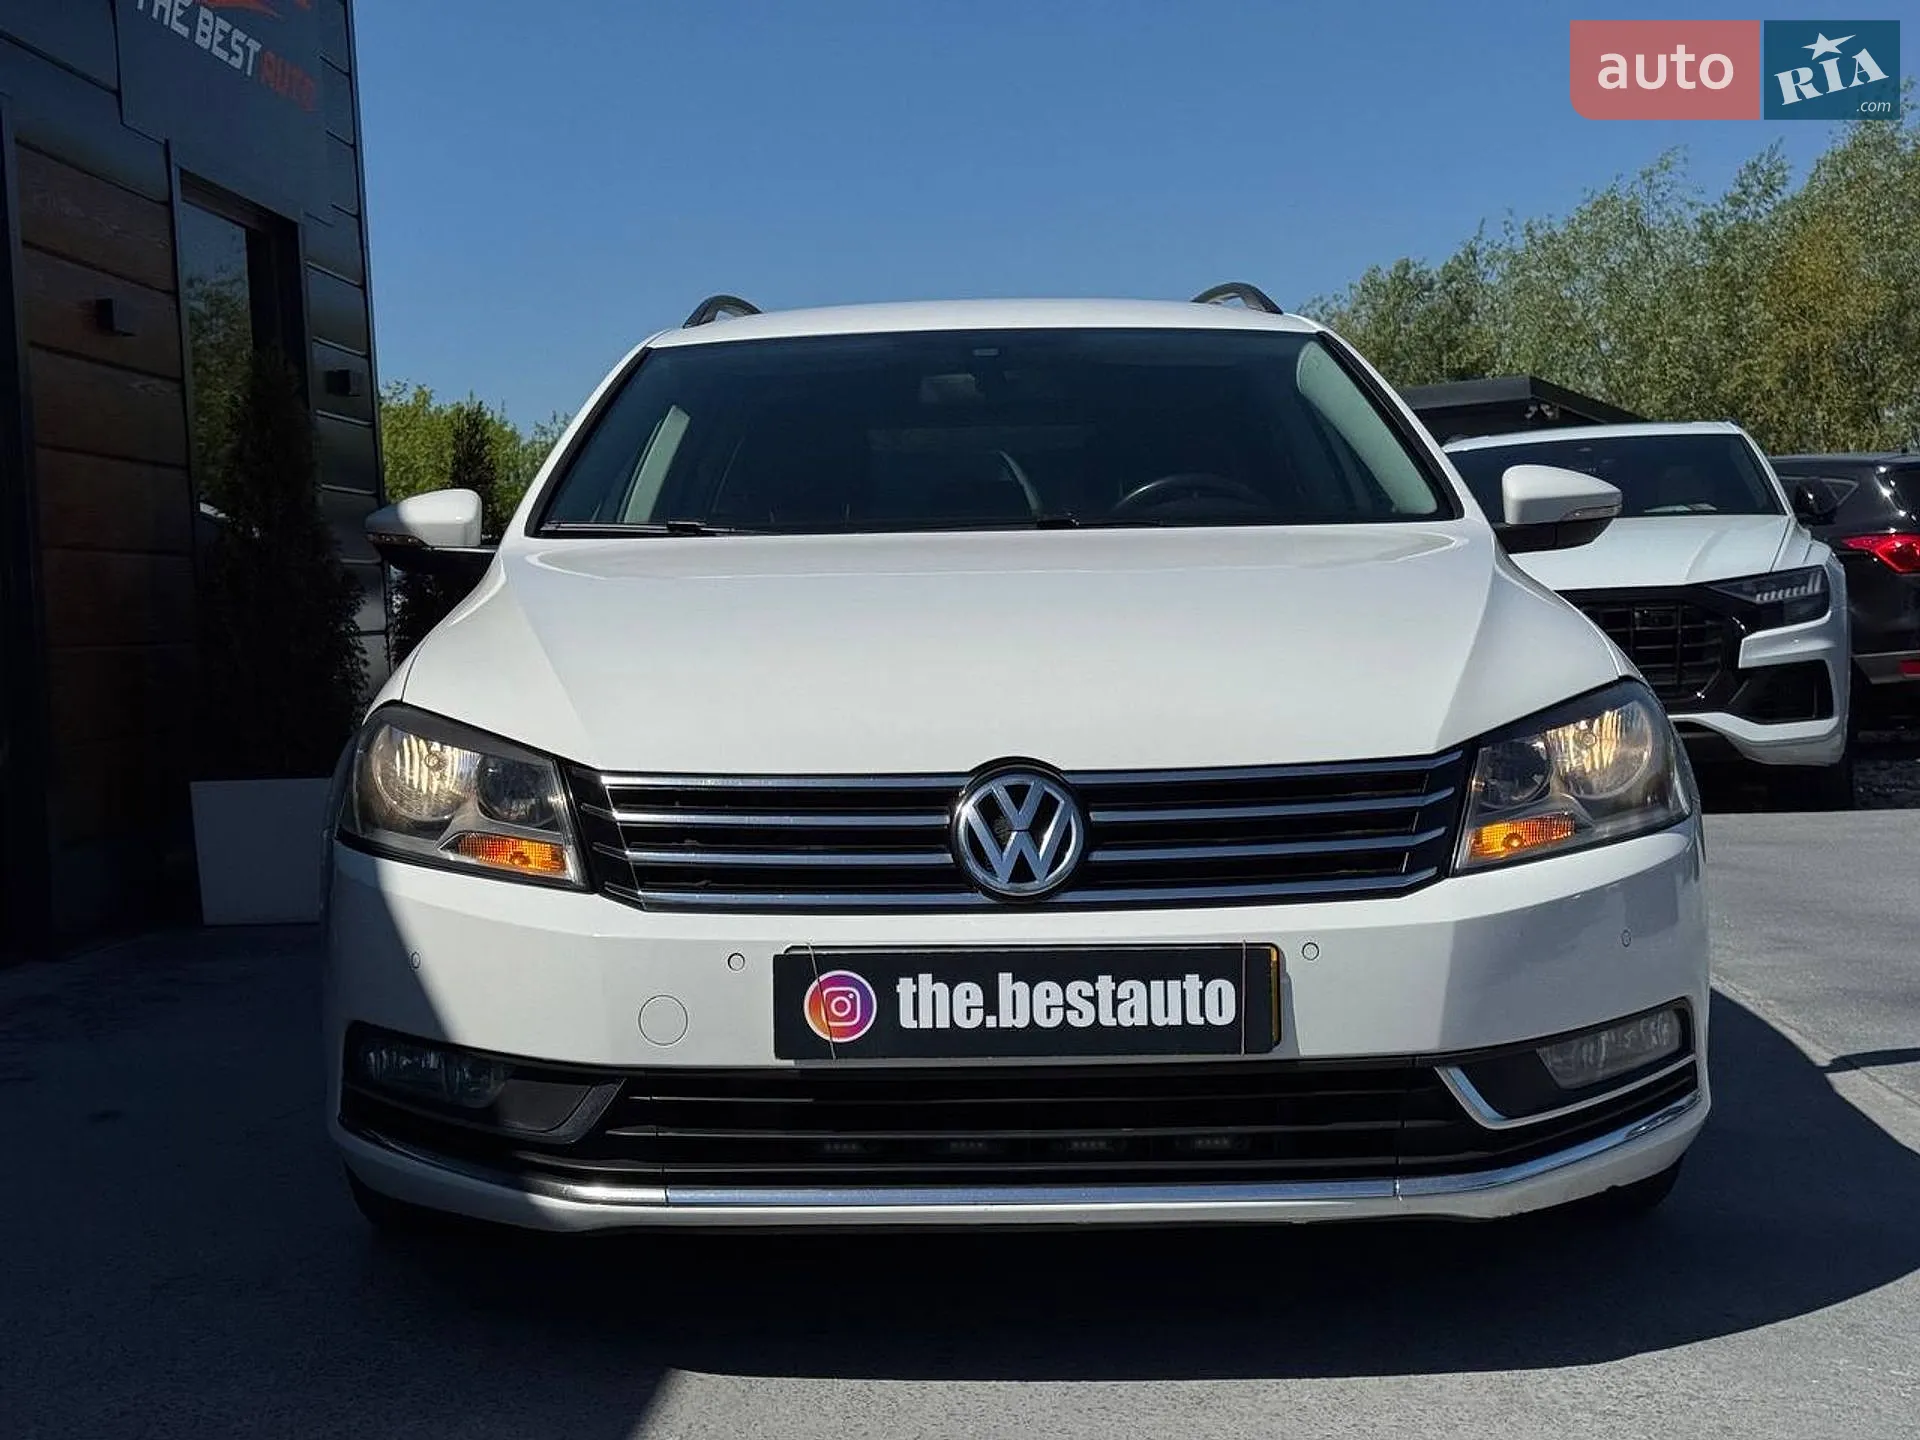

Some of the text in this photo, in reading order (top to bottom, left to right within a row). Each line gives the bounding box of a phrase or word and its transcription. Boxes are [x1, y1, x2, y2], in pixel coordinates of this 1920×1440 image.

[136, 0, 192, 39] HE
[195, 6, 262, 77] BEST
[896, 973, 1237, 1030] the.bestauto
